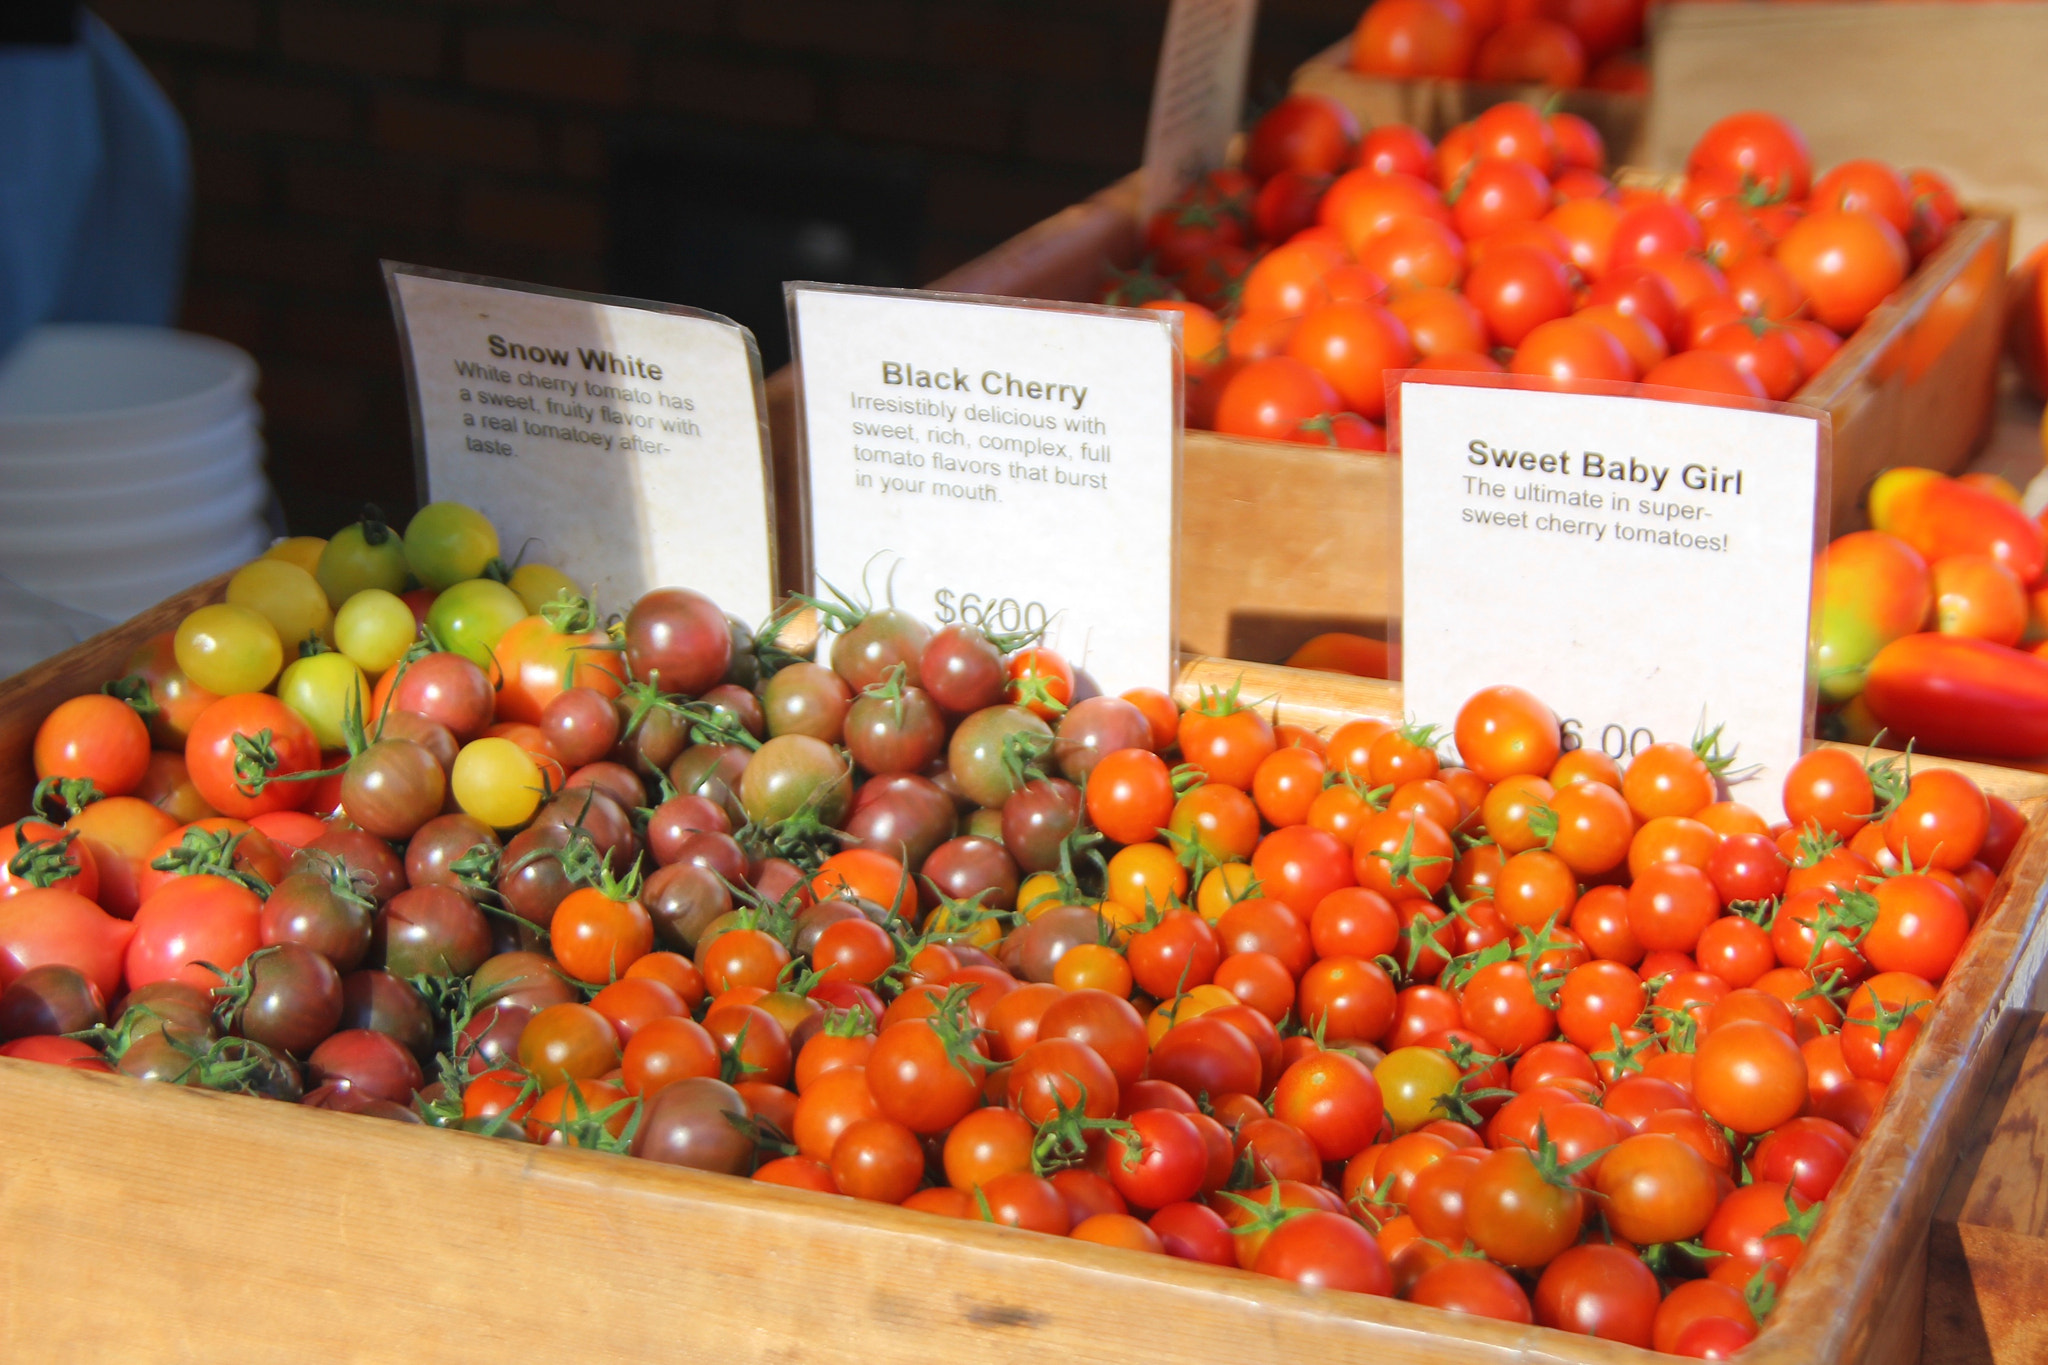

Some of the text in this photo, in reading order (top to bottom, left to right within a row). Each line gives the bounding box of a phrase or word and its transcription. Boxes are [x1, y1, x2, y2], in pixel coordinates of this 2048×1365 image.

[488, 334, 663, 380] Snow White
[454, 359, 695, 411] White cherry tomato has
[882, 360, 1088, 410] Black Cherry
[460, 388, 701, 437] a sweet, fruity flavor with
[463, 413, 671, 454] a real tomatoey after-
[850, 392, 1106, 435] Irresistibly delicious with
[466, 435, 519, 456] taste.
[852, 421, 1110, 463] sweet, rich, complex, full
[854, 444, 1108, 489] tomato flavors that burst
[855, 469, 1002, 503] in your mouth.
[1467, 439, 1743, 495] Sweet Baby Girl
[1462, 475, 1712, 521] The ultimate in super-
[1462, 508, 1728, 552] sweet cherry tomatoes!
[935, 587, 1046, 634] $600
